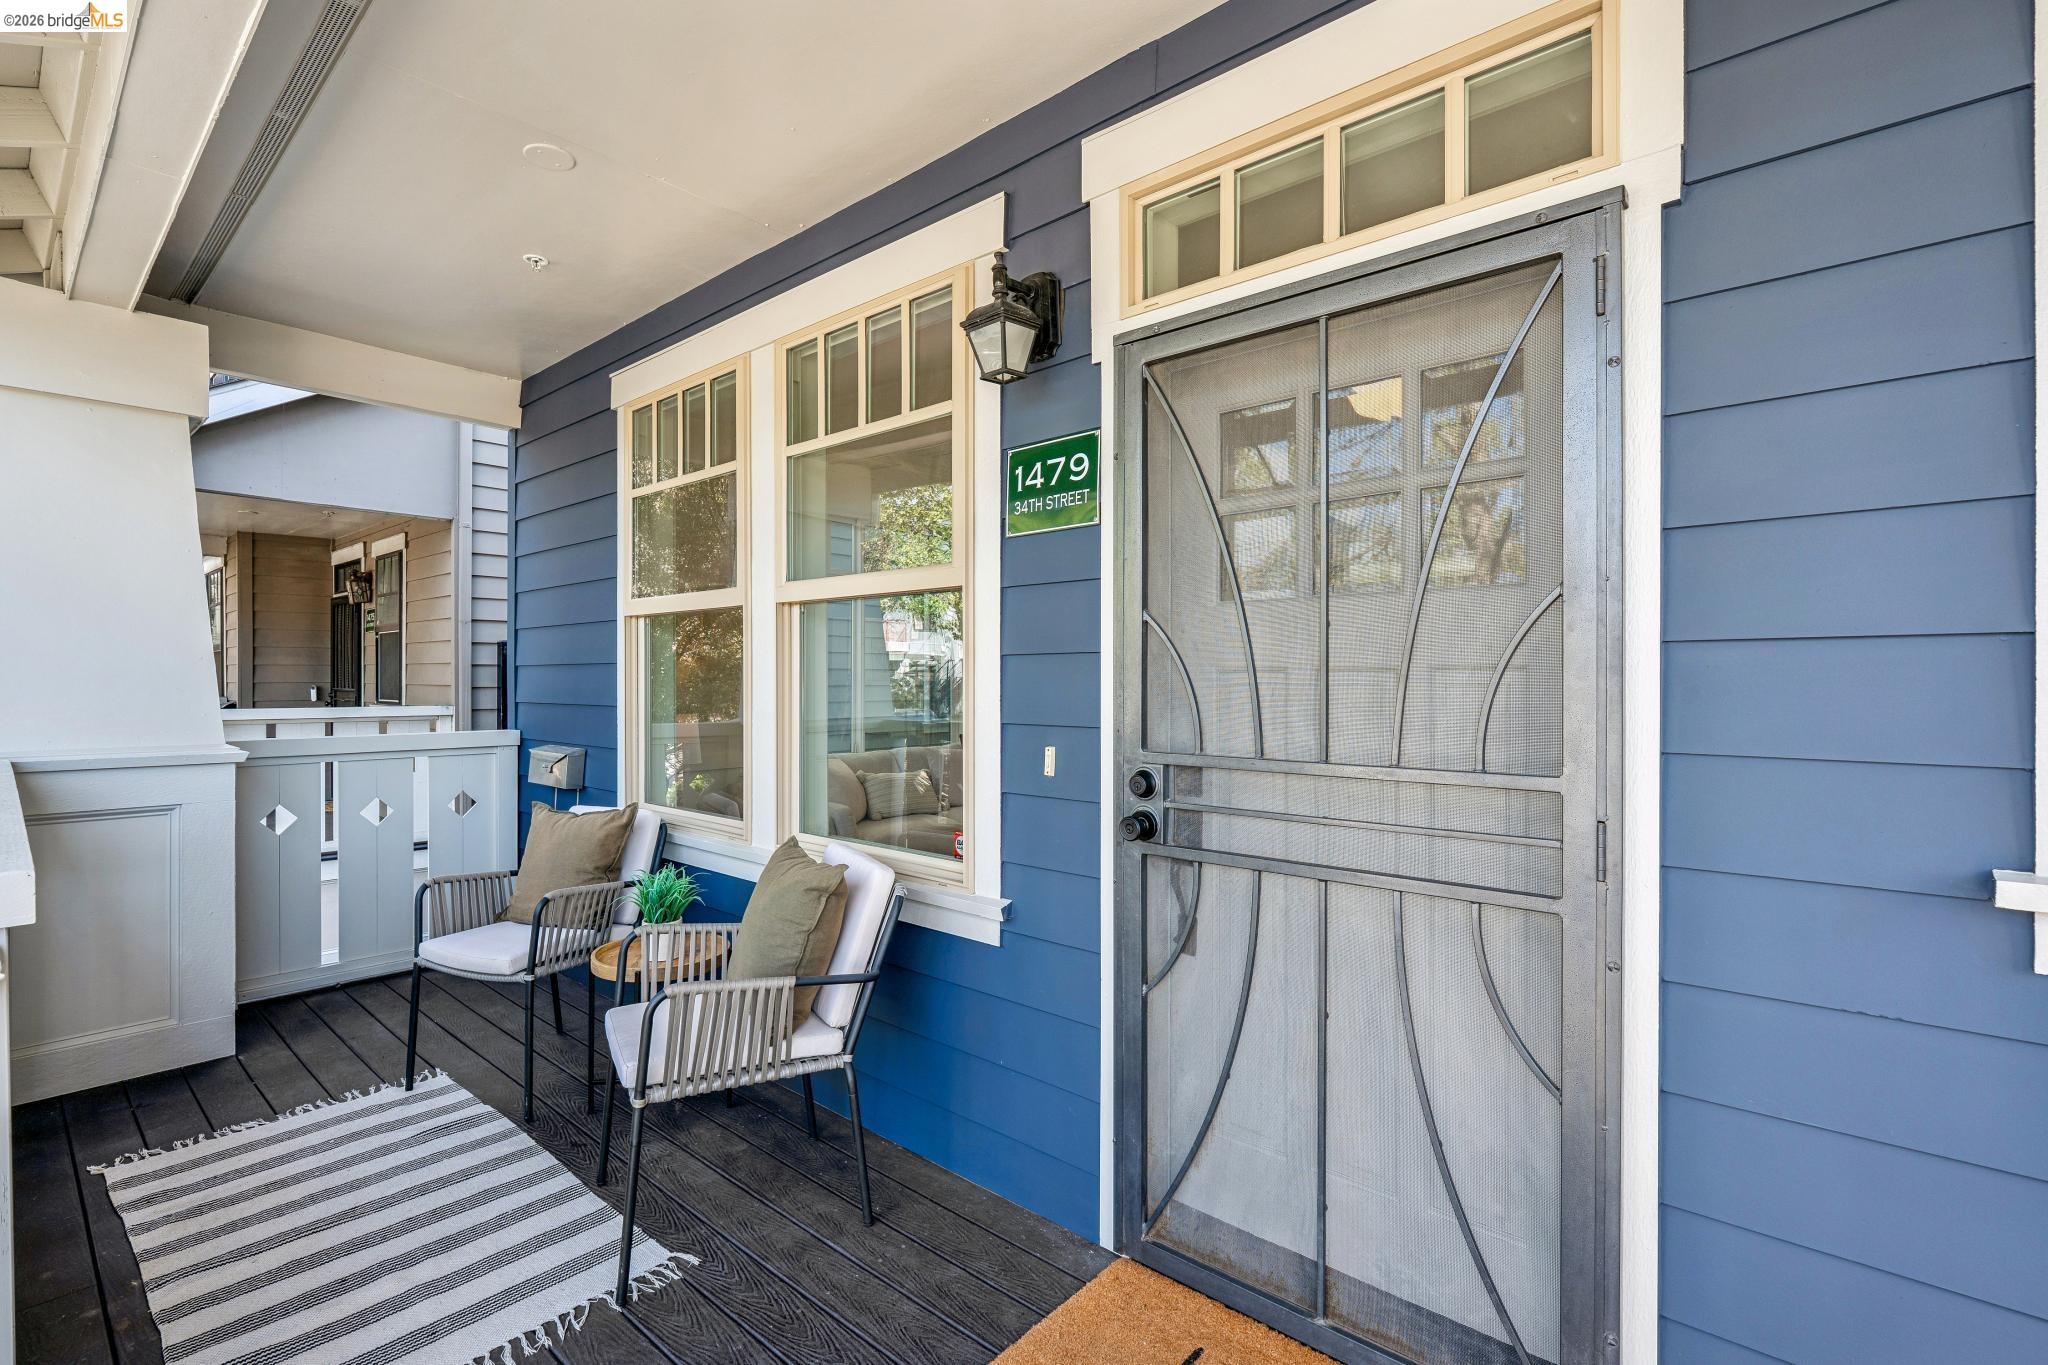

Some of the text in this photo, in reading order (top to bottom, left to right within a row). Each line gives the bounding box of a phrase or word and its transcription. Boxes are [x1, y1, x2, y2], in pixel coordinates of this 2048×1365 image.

[1016, 453, 1089, 492] 1479
[1014, 489, 1090, 515] 34TH STREET
